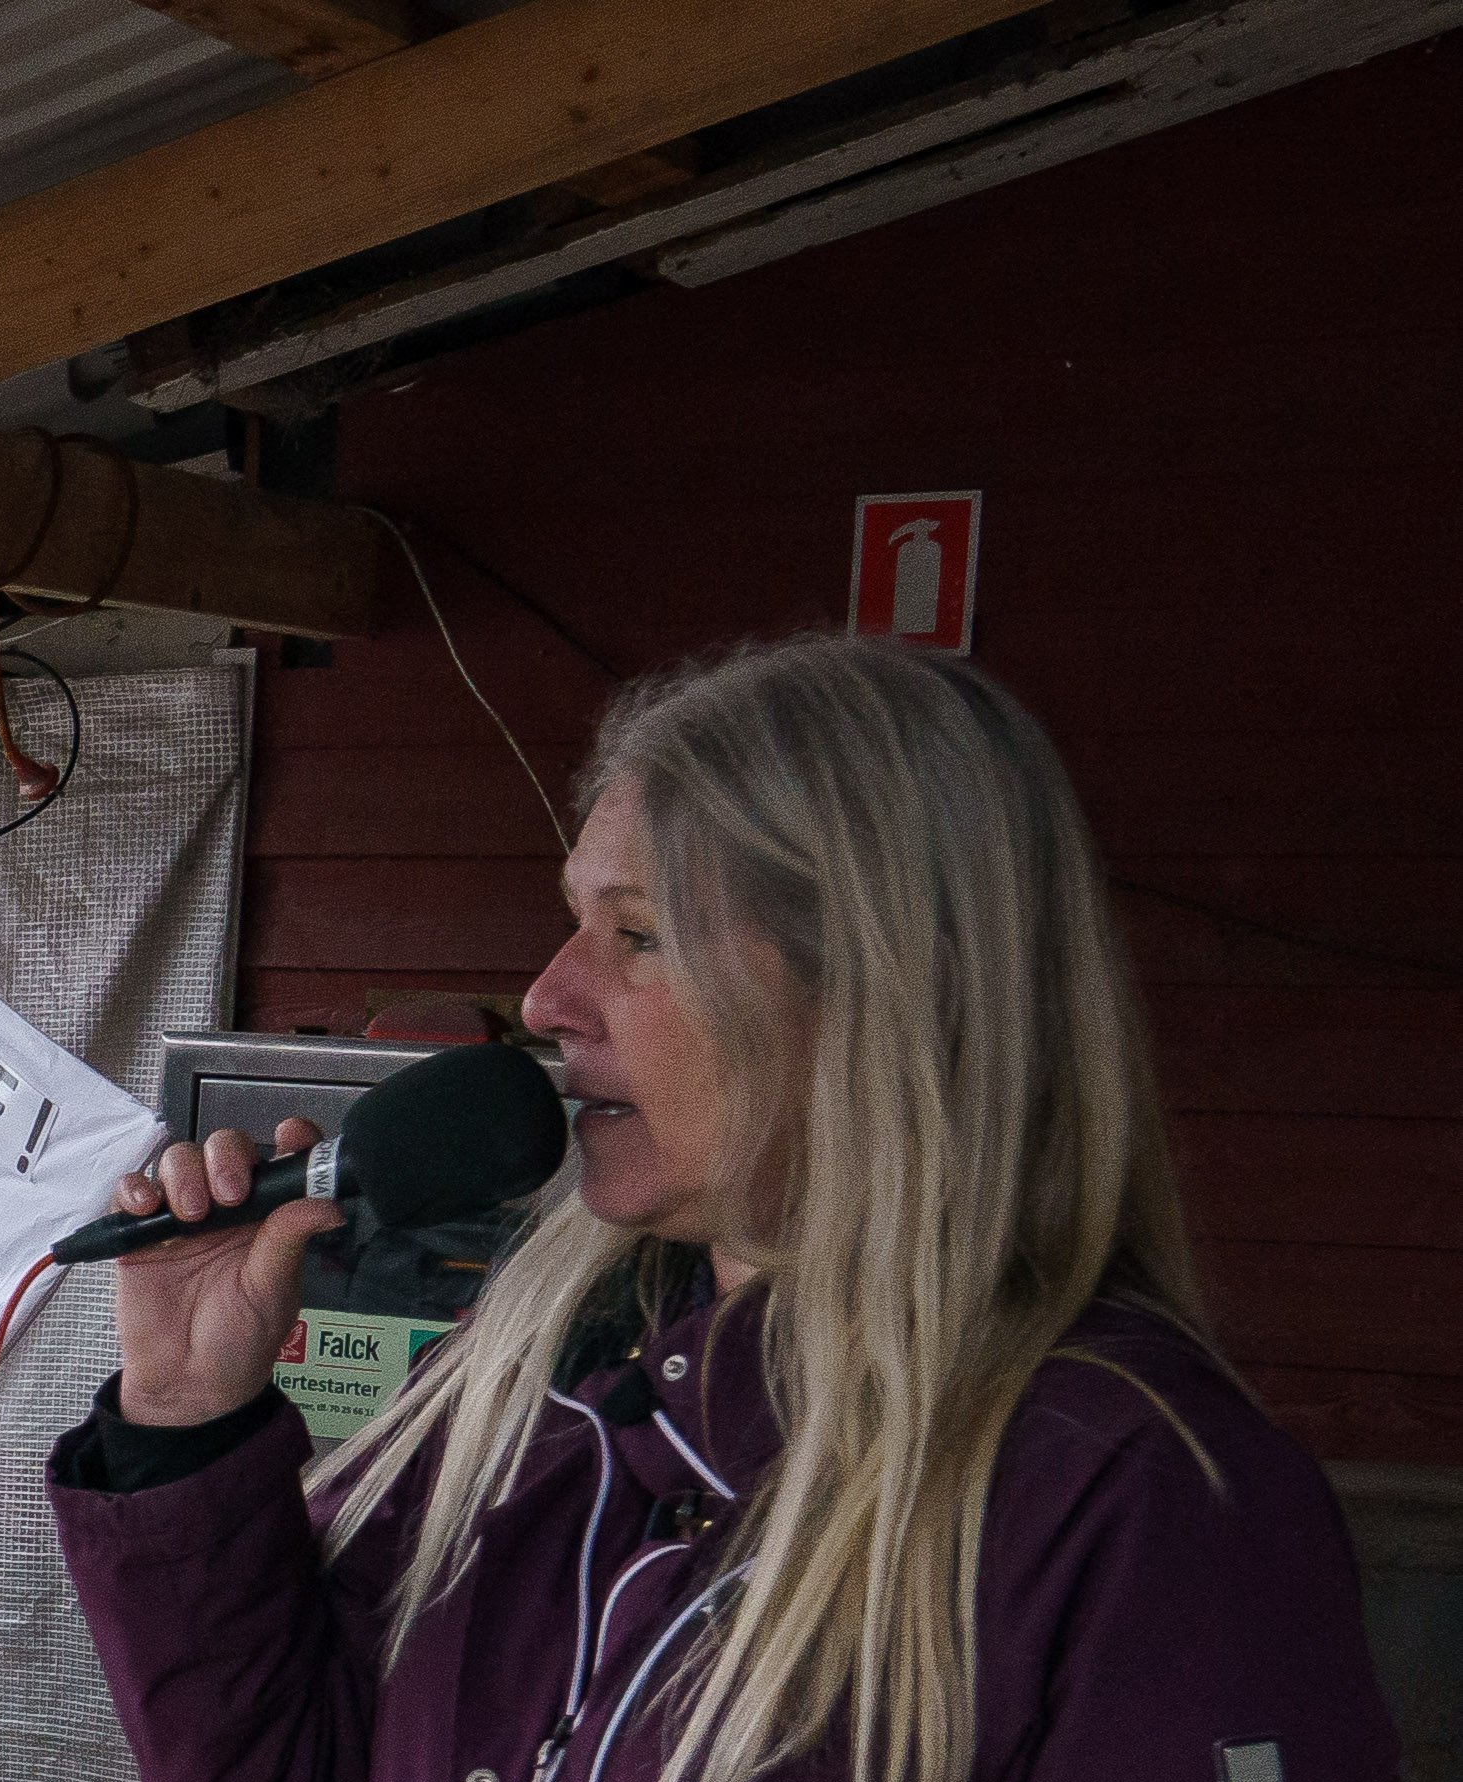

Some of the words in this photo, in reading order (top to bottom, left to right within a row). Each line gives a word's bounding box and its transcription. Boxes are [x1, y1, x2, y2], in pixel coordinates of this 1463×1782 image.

[17, 1098, 53, 1174] !
[311, 1140, 334, 1196] ORONA
[318, 1330, 380, 1362] Falck
[274, 1371, 381, 1399] jertestarter
